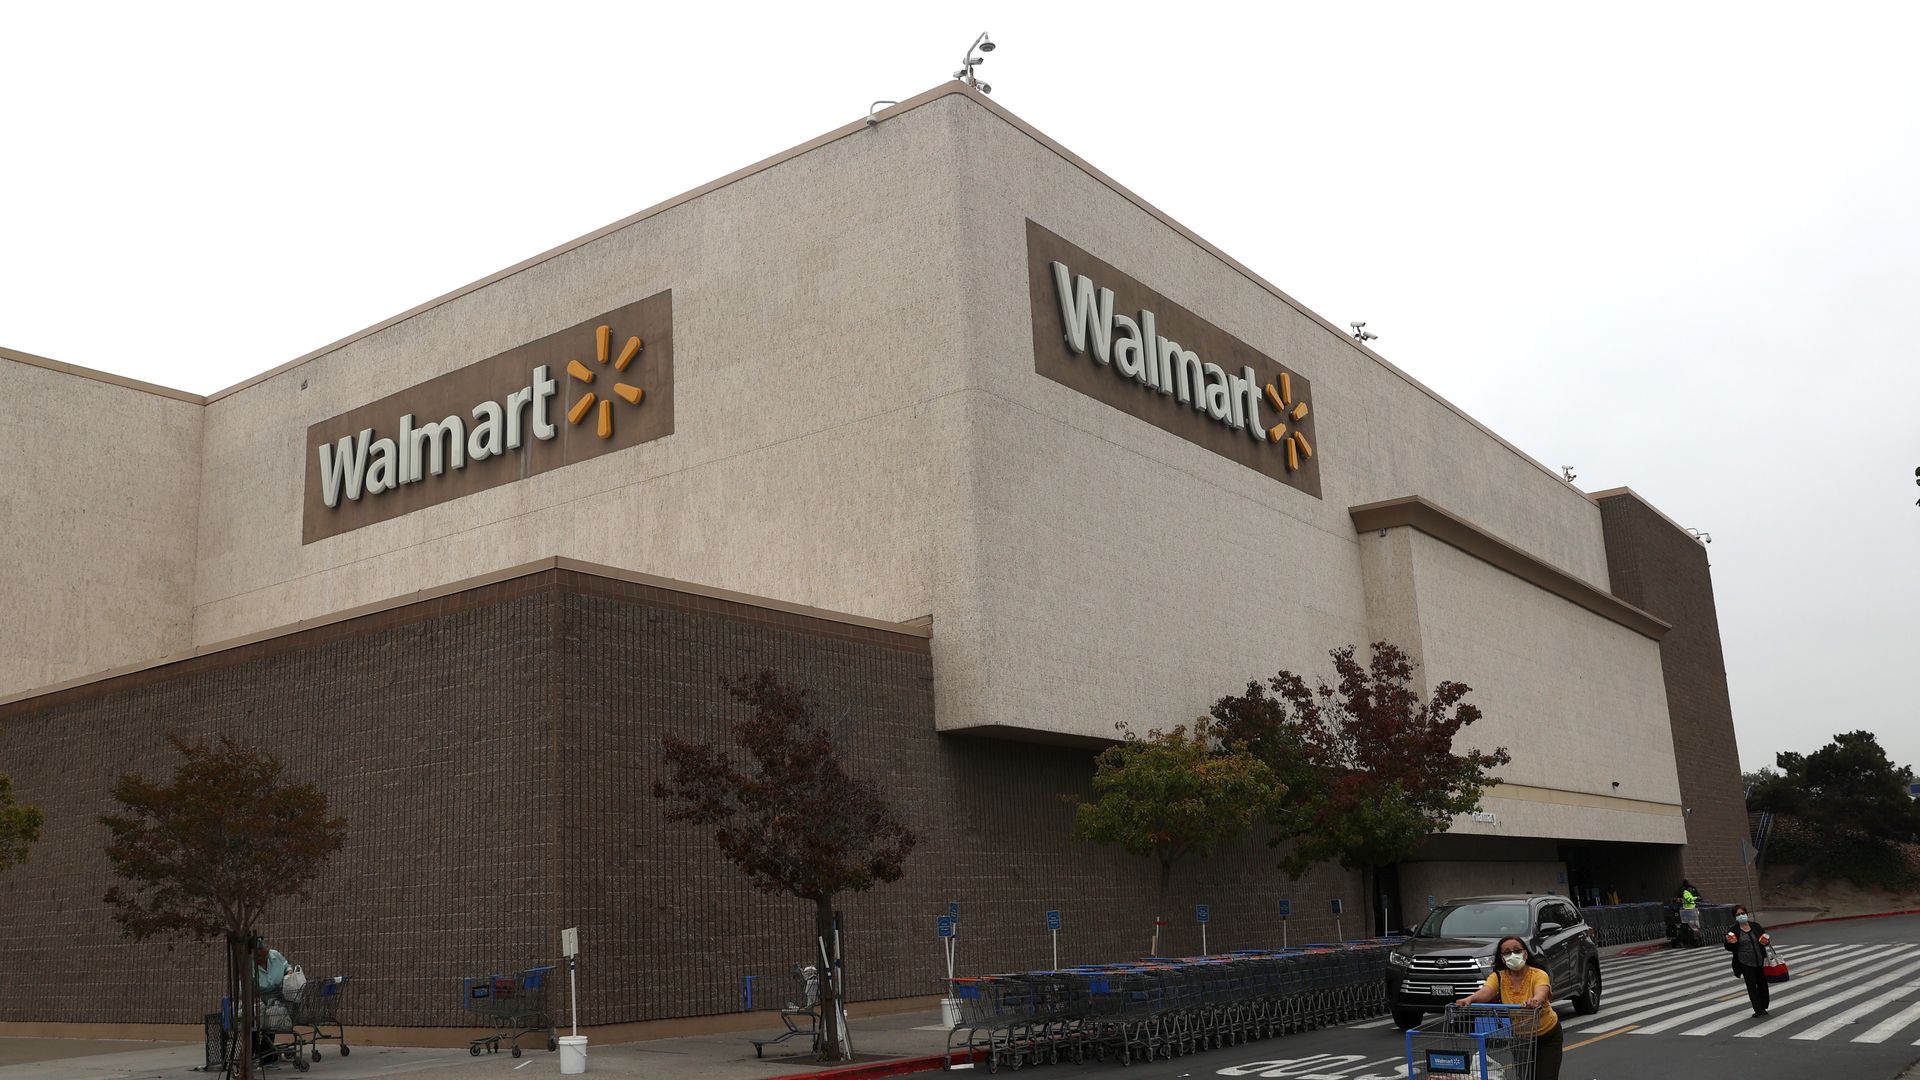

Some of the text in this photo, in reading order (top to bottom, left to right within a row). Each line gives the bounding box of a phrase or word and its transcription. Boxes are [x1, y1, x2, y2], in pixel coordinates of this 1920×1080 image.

[1050, 260, 1266, 440] Walmart
[318, 364, 556, 508] Walmart
[1434, 1057, 1453, 1065] Walmart
